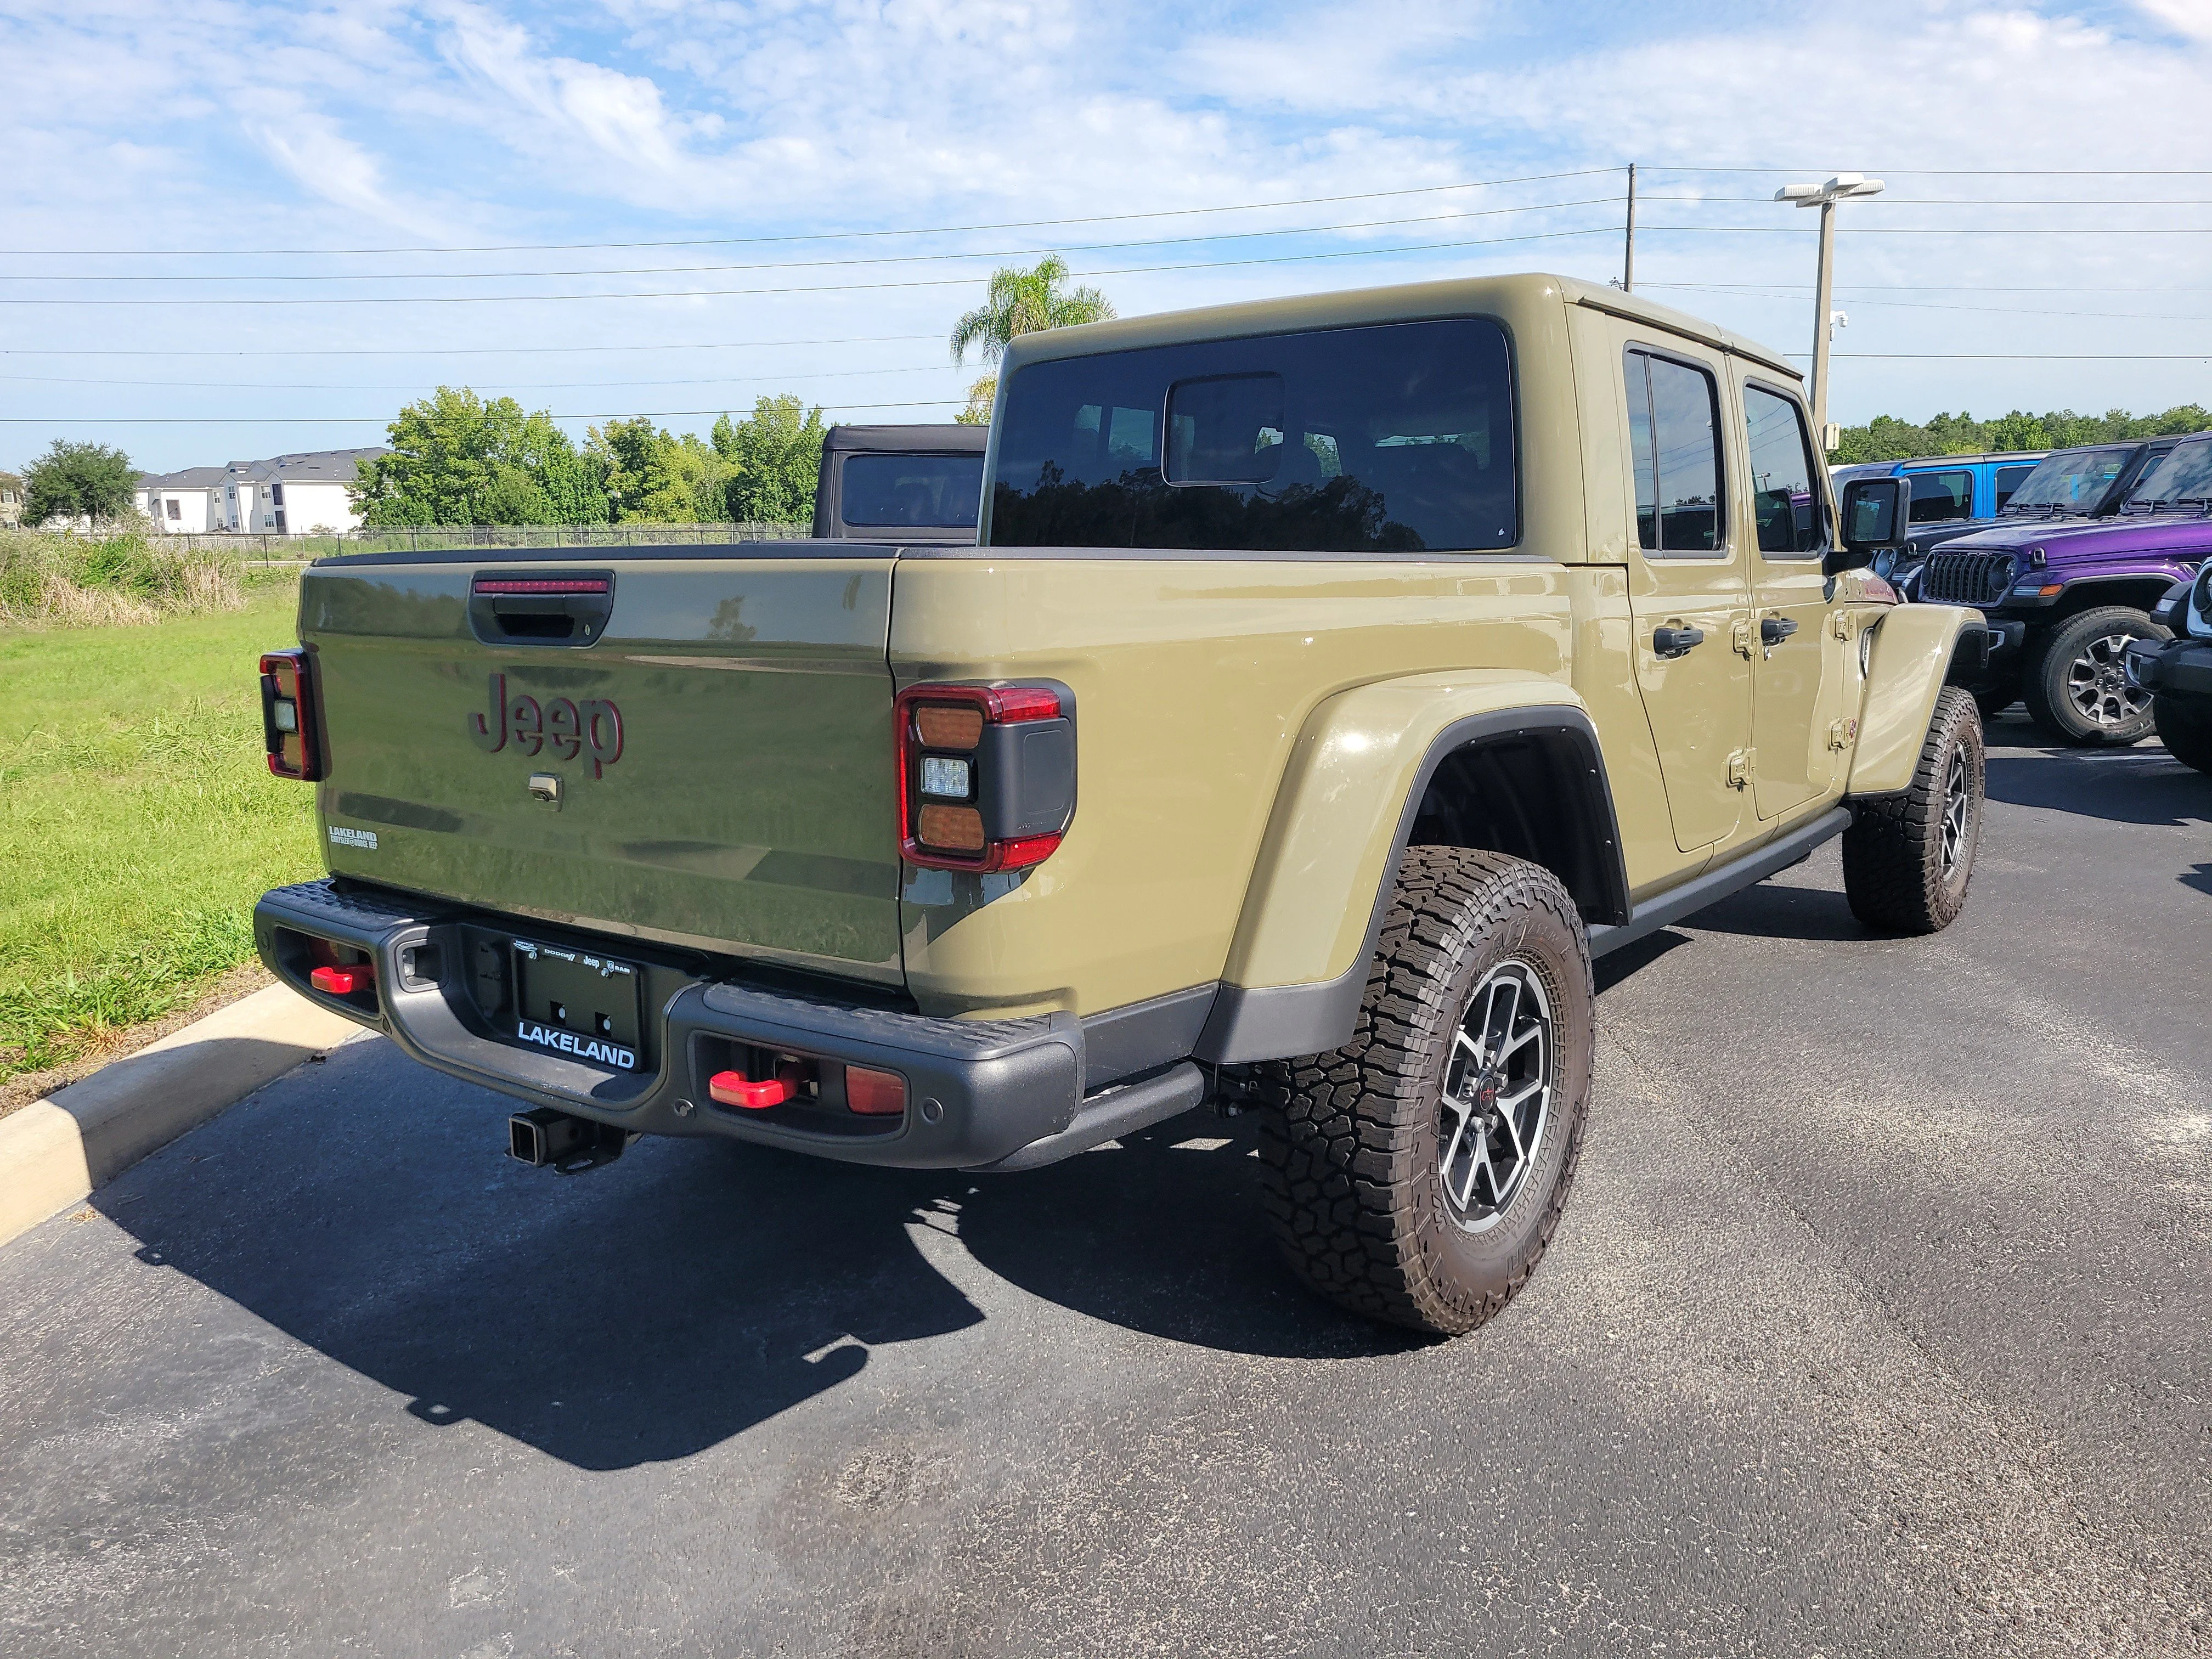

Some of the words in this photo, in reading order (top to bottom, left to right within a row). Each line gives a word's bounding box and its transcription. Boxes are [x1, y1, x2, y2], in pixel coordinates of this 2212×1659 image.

[468, 673, 624, 780] Jeep
[329, 825, 377, 842] LAKELAND
[583, 955, 600, 969] Jeep
[518, 1022, 634, 1069] LAKELAND
